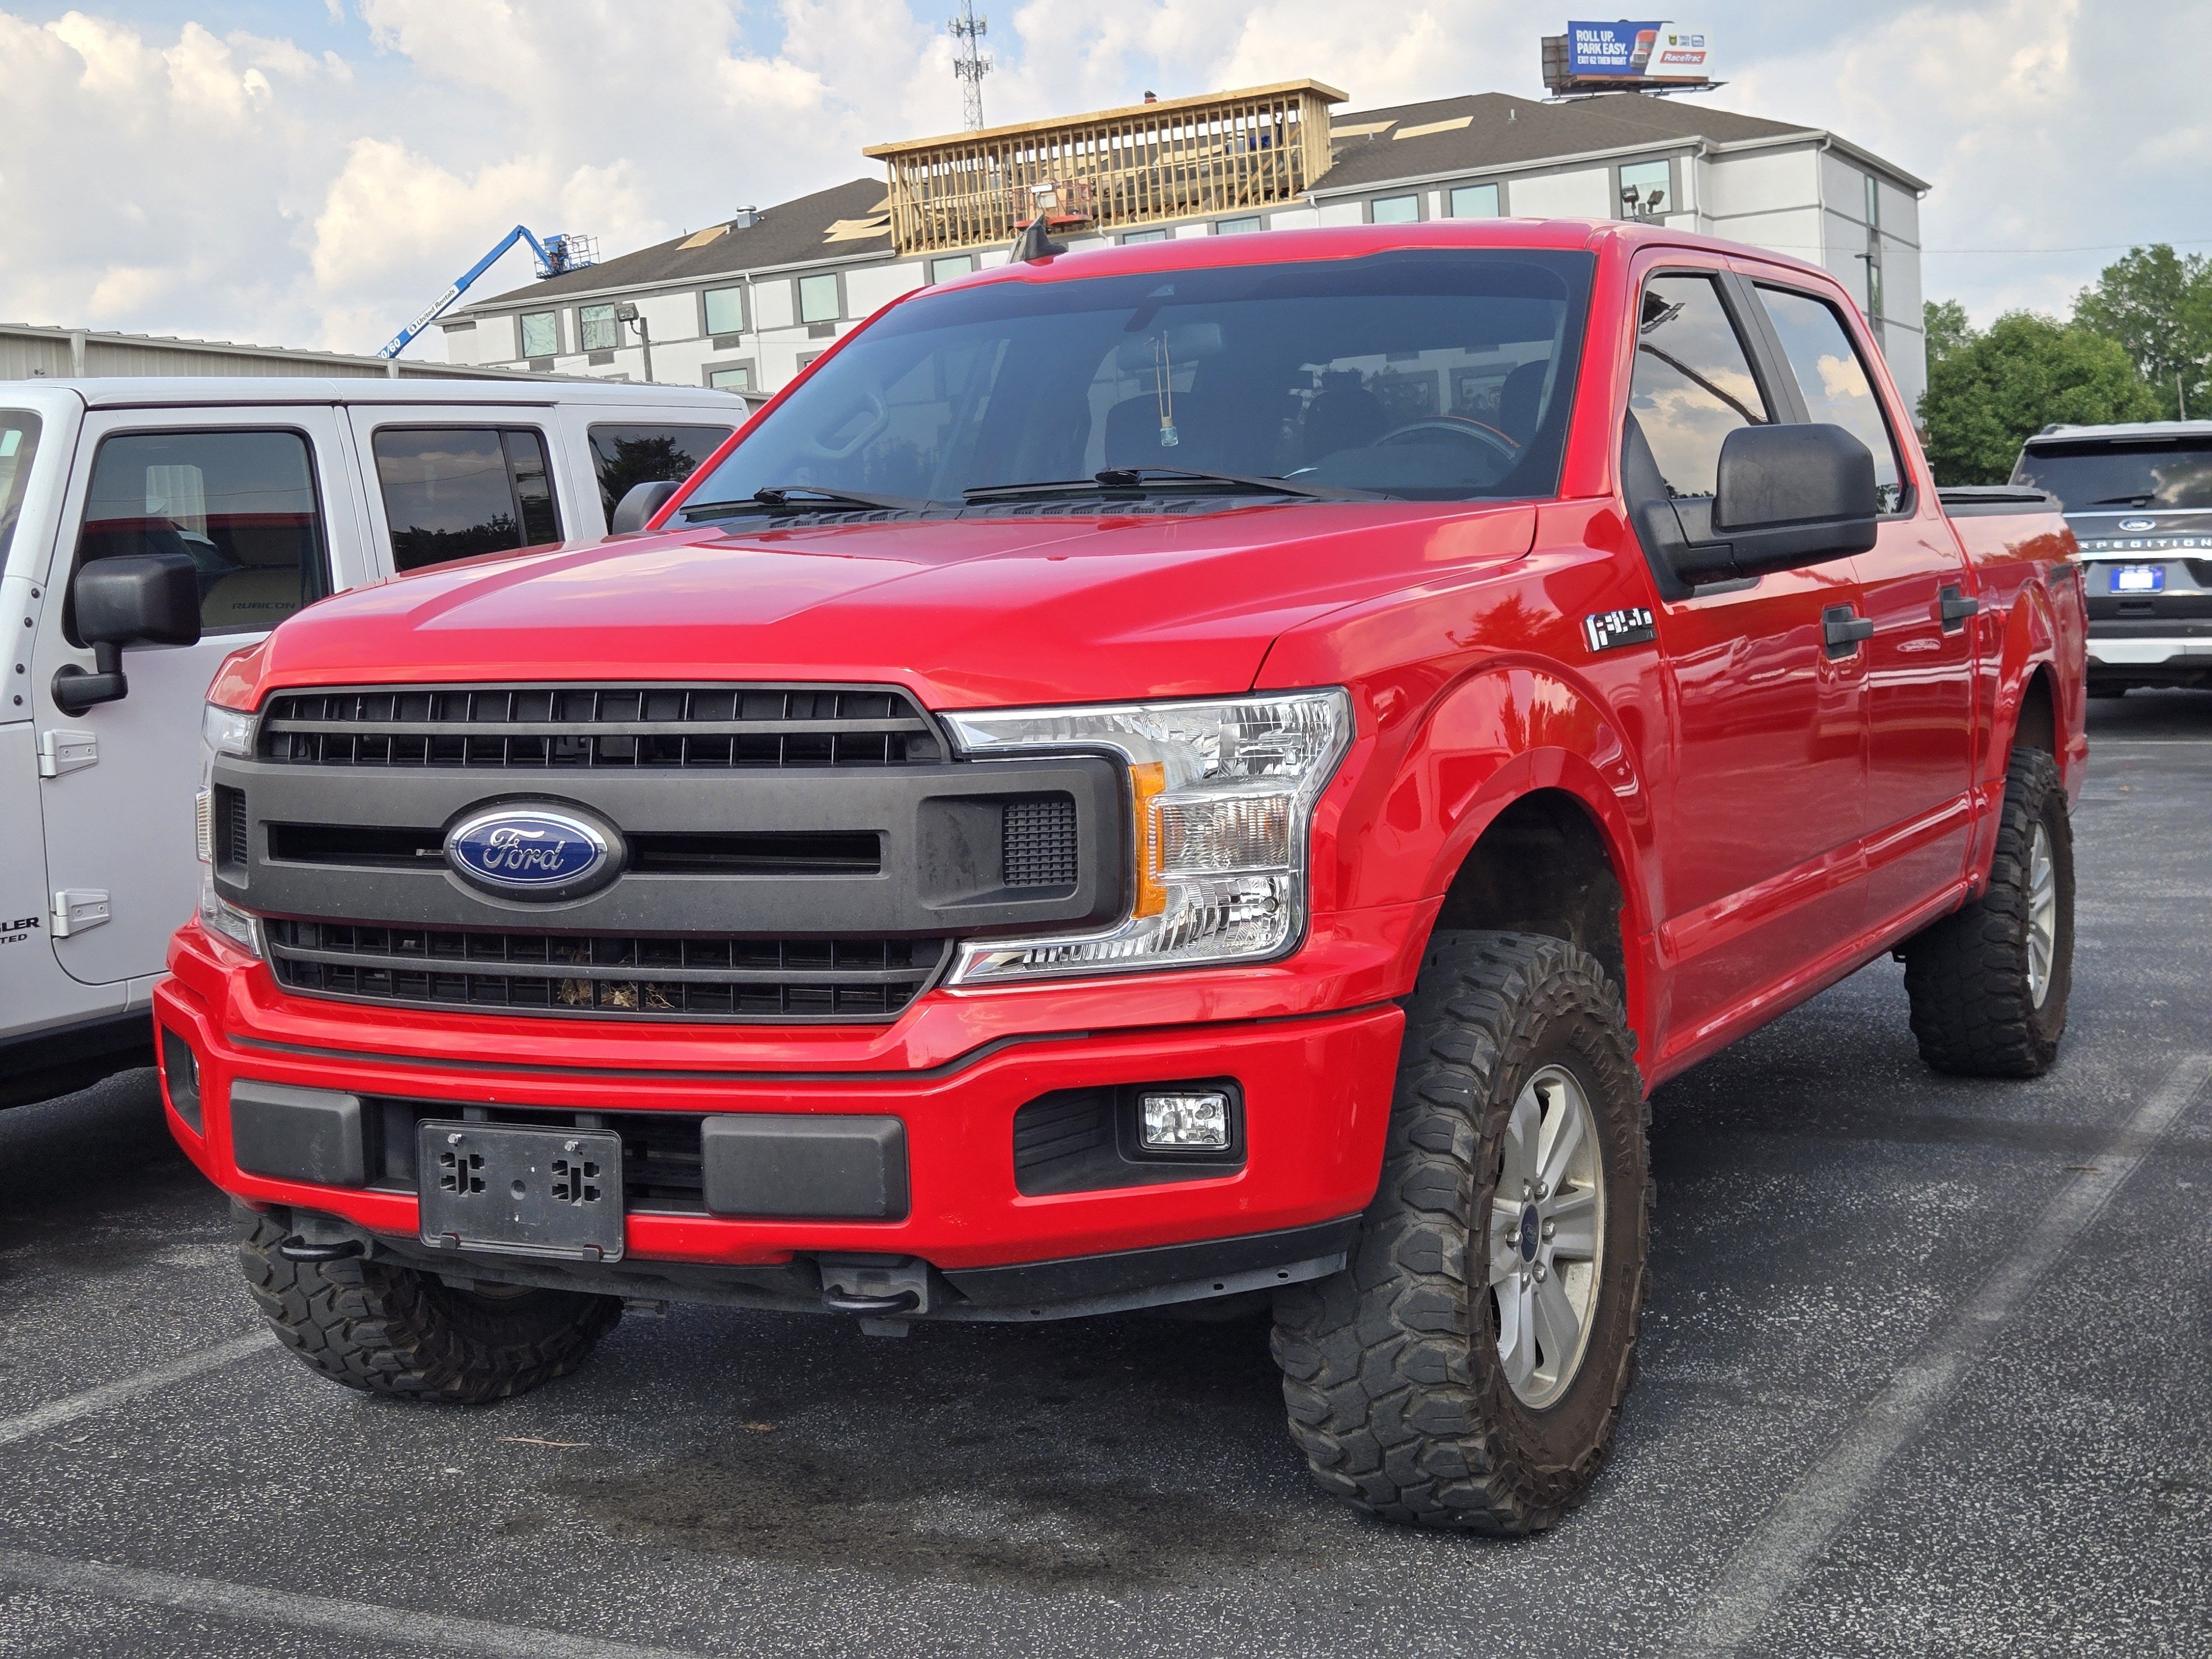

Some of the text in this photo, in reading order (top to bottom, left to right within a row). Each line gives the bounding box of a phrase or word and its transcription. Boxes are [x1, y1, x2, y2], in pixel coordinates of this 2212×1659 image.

[1576, 30, 1615, 42] ROLL UP.
[1577, 43, 1628, 55] PARK EASY.
[1664, 53, 1702, 62] RaceTrac
[416, 288, 456, 325] United Rentals
[2078, 538, 2212, 549] XPEDITION
[483, 827, 566, 870] Ford
[0, 917, 41, 933] LER
